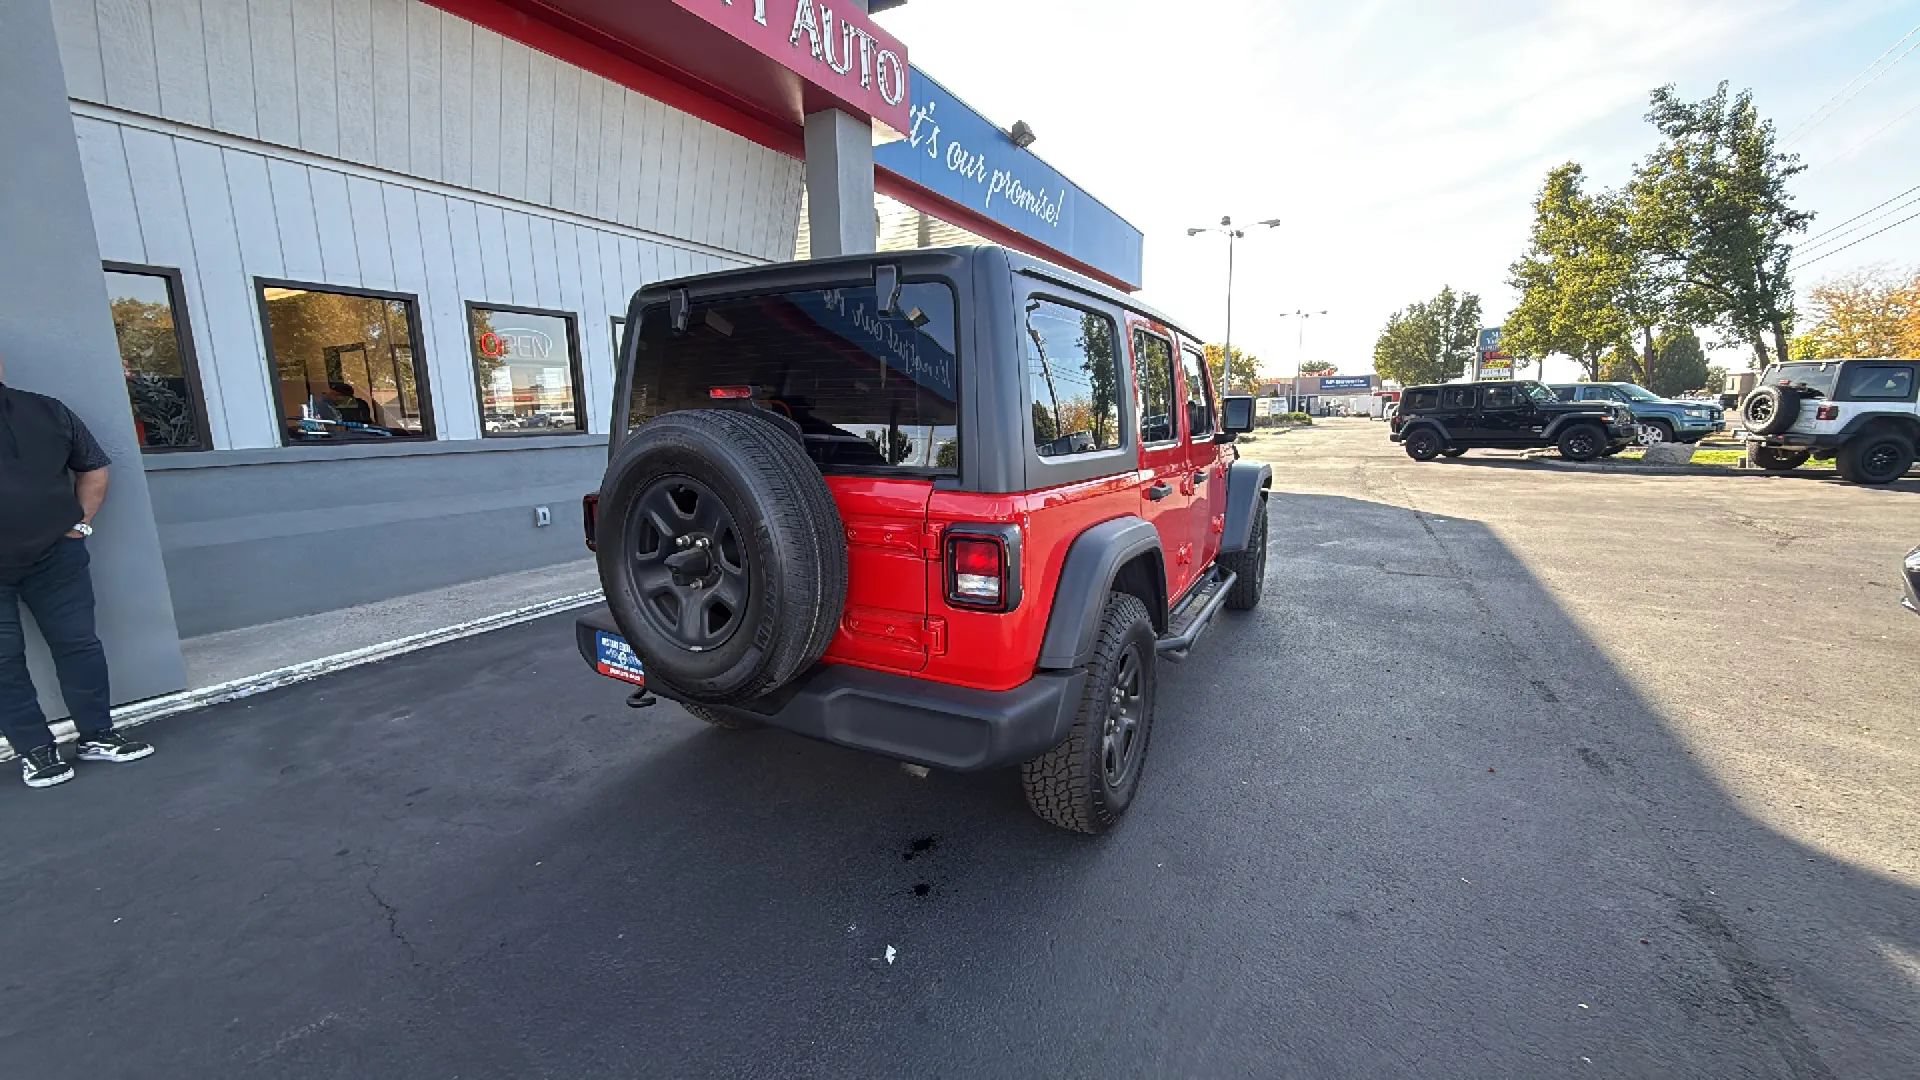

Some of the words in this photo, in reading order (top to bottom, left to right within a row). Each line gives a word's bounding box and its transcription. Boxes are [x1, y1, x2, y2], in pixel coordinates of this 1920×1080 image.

[789, 0, 905, 105] AUTO
[947, 142, 987, 184] our
[986, 165, 1065, 228] promise!
[480, 332, 550, 359] OPEN
